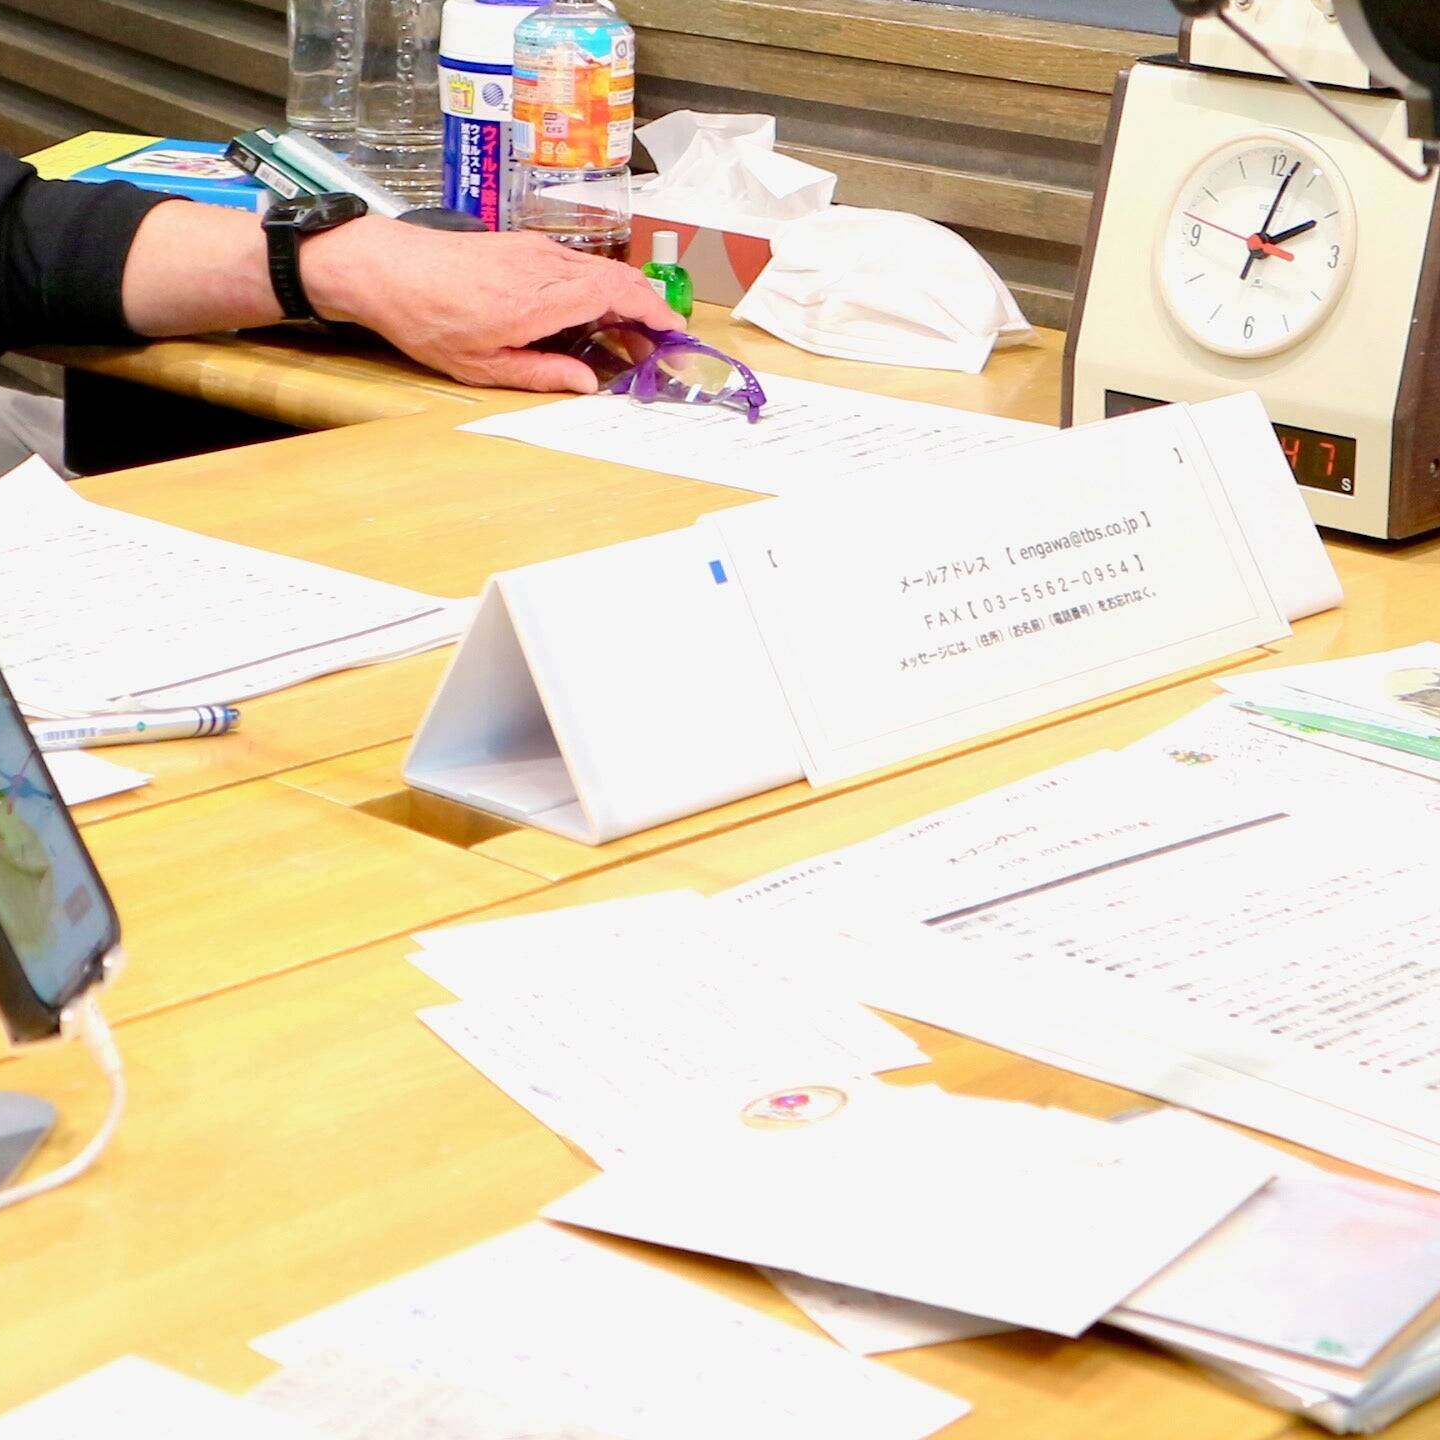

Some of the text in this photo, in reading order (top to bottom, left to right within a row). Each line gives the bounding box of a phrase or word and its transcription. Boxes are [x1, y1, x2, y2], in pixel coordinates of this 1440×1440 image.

[1270, 154, 1288, 177] 12
[1189, 223, 1202, 247] 9
[1327, 244, 1340, 269] 3
[1243, 315, 1256, 340] 6
[1340, 477, 1352, 492] S
[899, 556, 990, 594] メールアドレス
